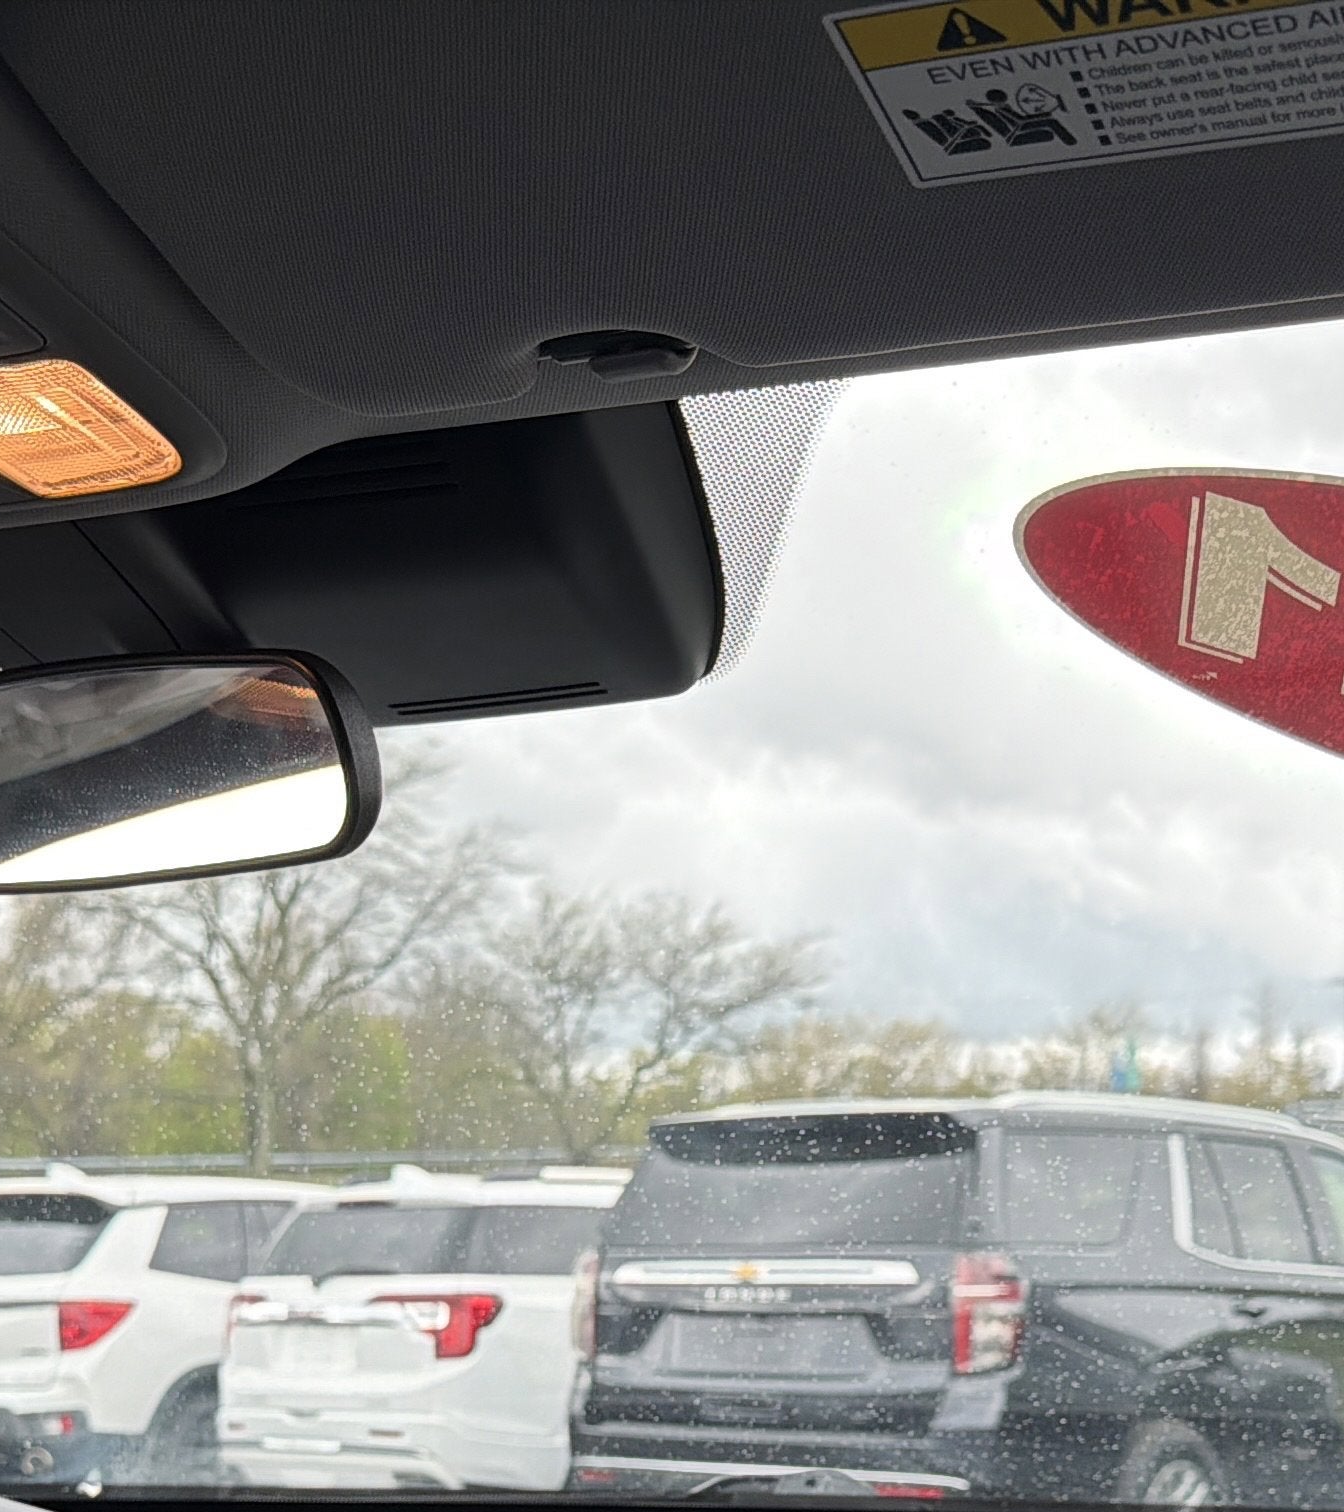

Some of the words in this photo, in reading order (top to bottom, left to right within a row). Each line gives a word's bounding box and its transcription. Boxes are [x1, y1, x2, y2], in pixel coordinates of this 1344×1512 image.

[927, 55, 1014, 85] EVEN
[1020, 43, 1106, 70] WITH
[1115, 14, 1299, 58] ADVANCED
[1088, 61, 1153, 80] Children
[1156, 58, 1184, 71] can
[1189, 52, 1208, 66] be
[1213, 45, 1253, 62] killed
[1258, 44, 1273, 55] or
[1095, 82, 1126, 96] The
[1131, 76, 1165, 92] back
[1171, 71, 1203, 86] seat
[1207, 68, 1220, 80] is
[1224, 64, 1249, 78] the
[1253, 57, 1301, 74] safest
[1102, 97, 1148, 113] Never
[1152, 92, 1178, 108] put
[1195, 79, 1277, 101] rear-facing
[1281, 71, 1318, 89] child
[1110, 111, 1163, 130] Always
[1167, 107, 1195, 119] use
[1199, 102, 1232, 116] seat
[1235, 95, 1273, 113] belts
[1276, 91, 1306, 106] and
[1115, 130, 1147, 145] See
[1150, 119, 1208, 140] owner's
[1211, 114, 1268, 133] manual
[1271, 110, 1292, 124] for
[1296, 106, 1336, 120] more
